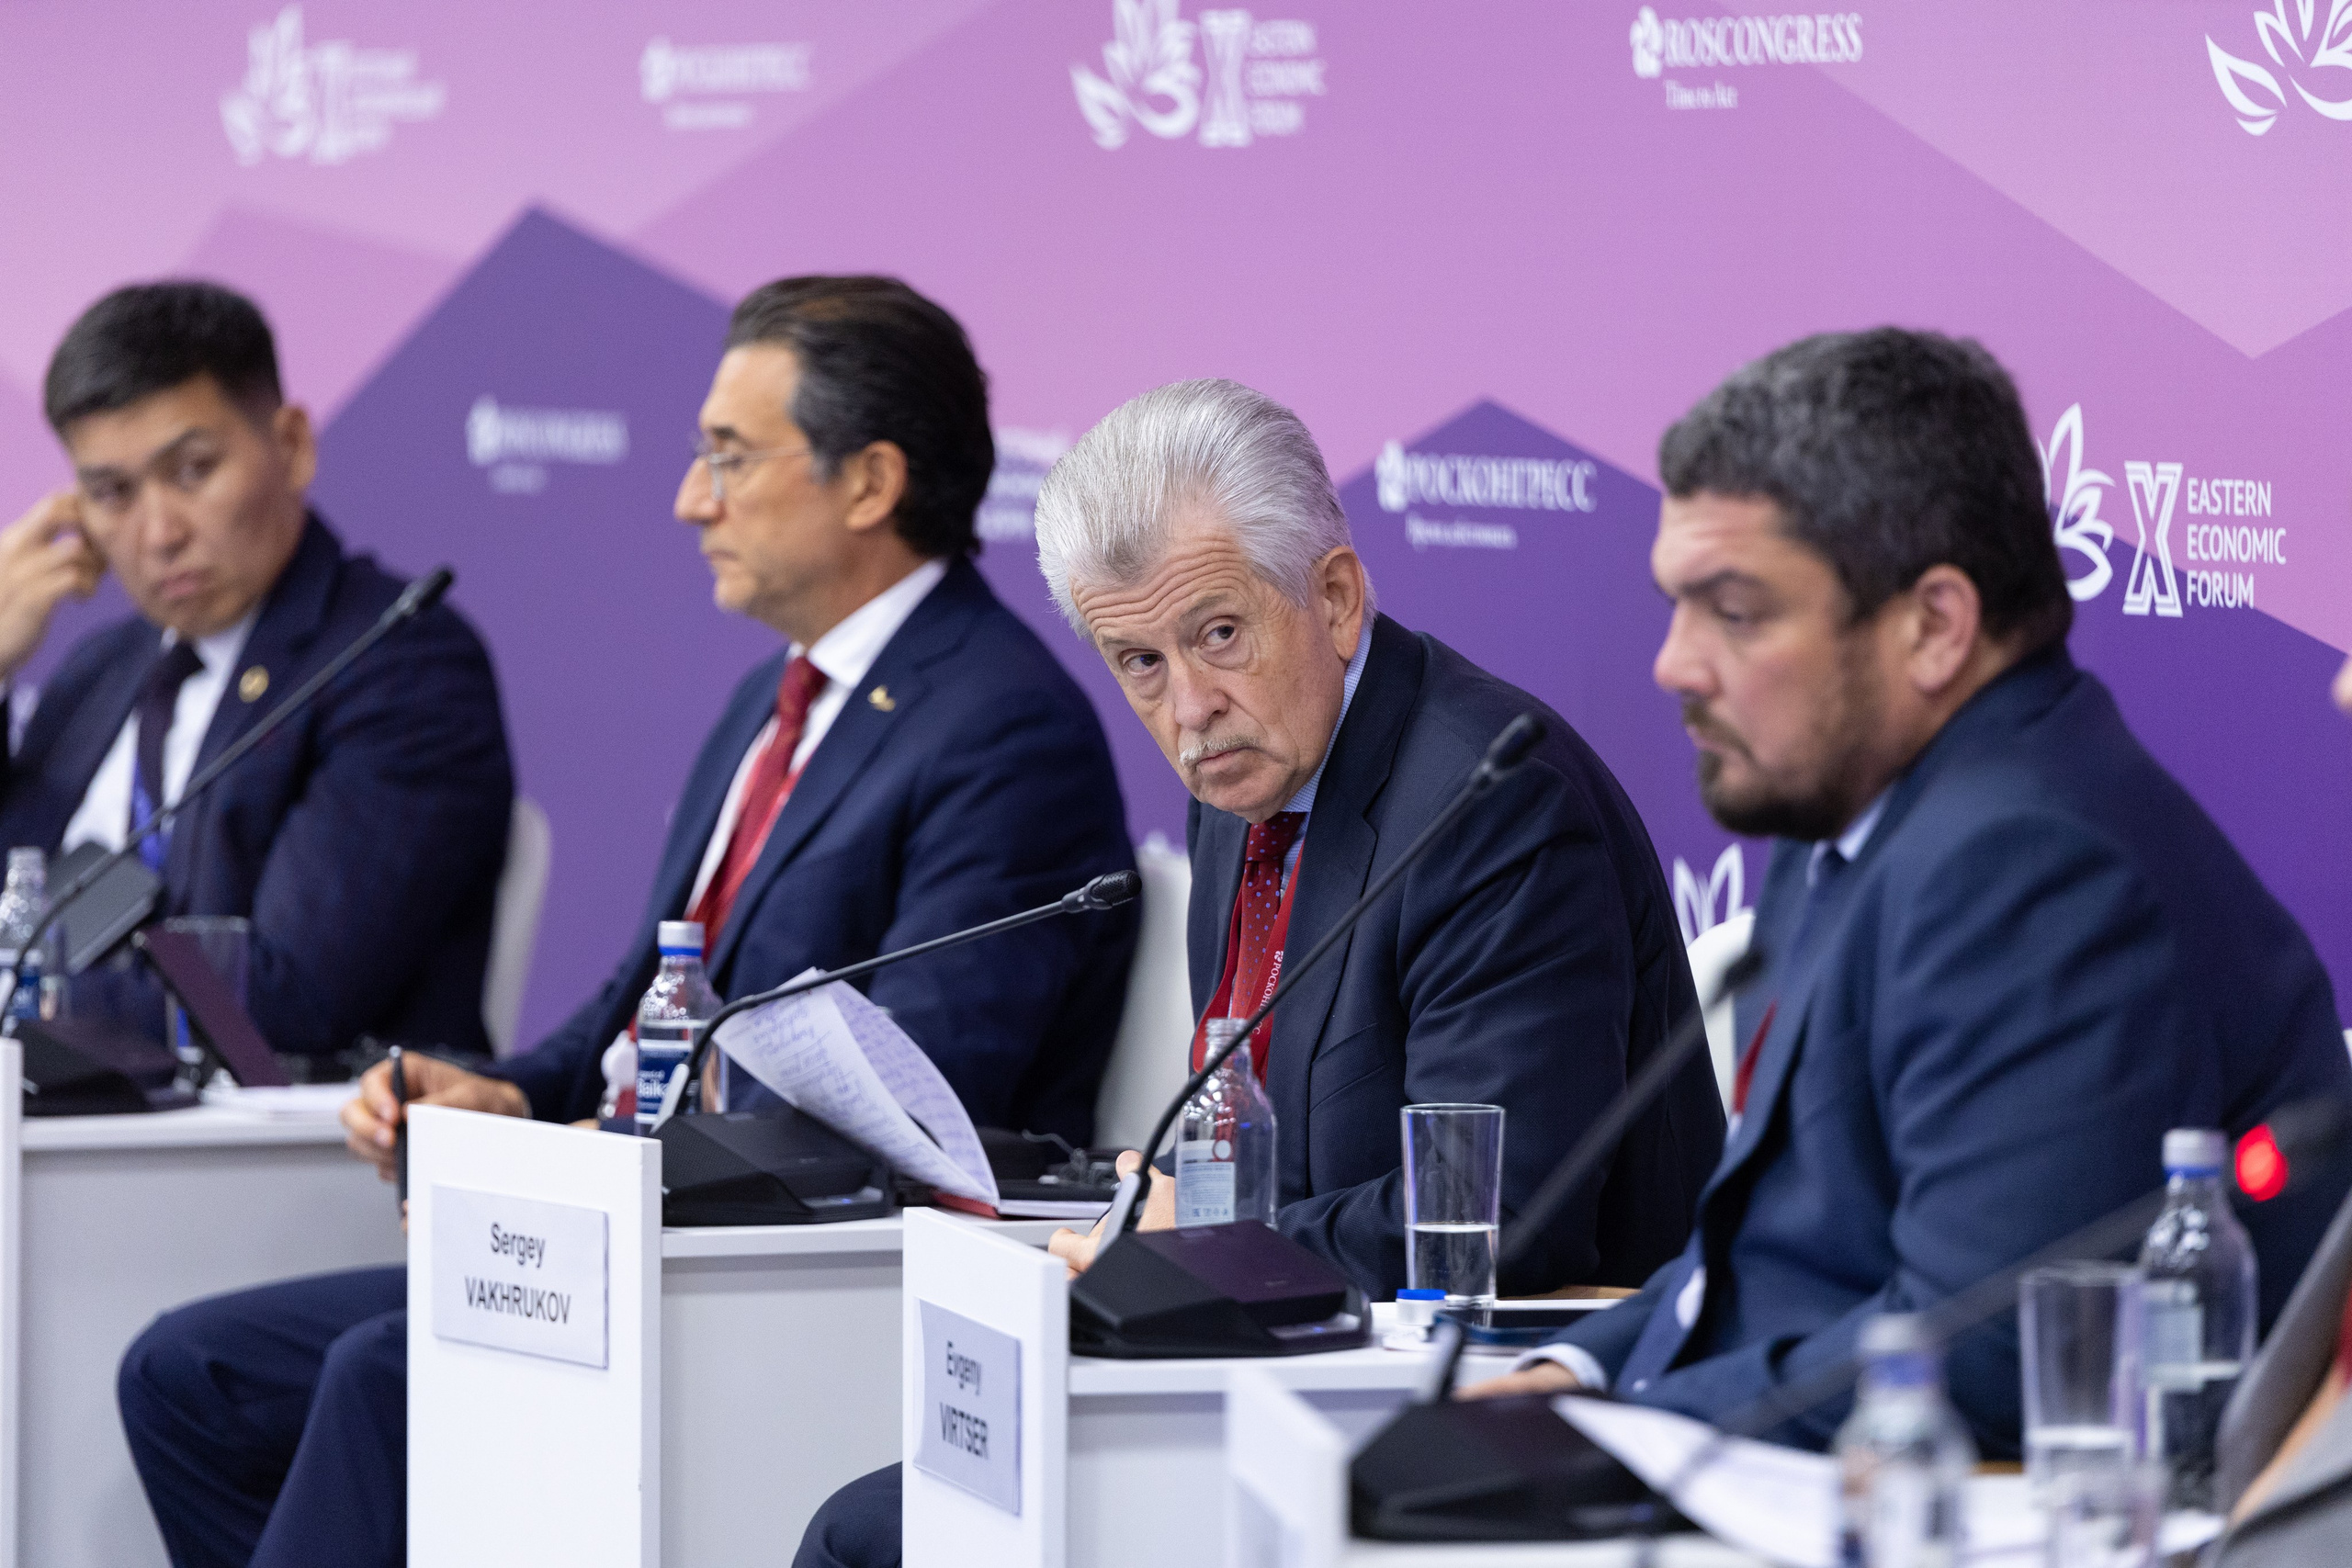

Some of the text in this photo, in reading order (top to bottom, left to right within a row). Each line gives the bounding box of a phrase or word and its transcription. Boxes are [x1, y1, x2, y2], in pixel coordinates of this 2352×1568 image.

[1664, 12, 1862, 67] ROSCONGRESS
[1407, 454, 1597, 513] РОСКОНГРЕСС
[2187, 478, 2271, 517] EASTERN
[2187, 525, 2287, 564] ECONOMIC
[2187, 570, 2255, 609] FORUM
[491, 1222, 546, 1269] Sergey
[465, 1275, 571, 1324] VAKHRUKOV
[946, 1340, 981, 1396] Evgeny
[940, 1402, 989, 1461] VIRTSER
